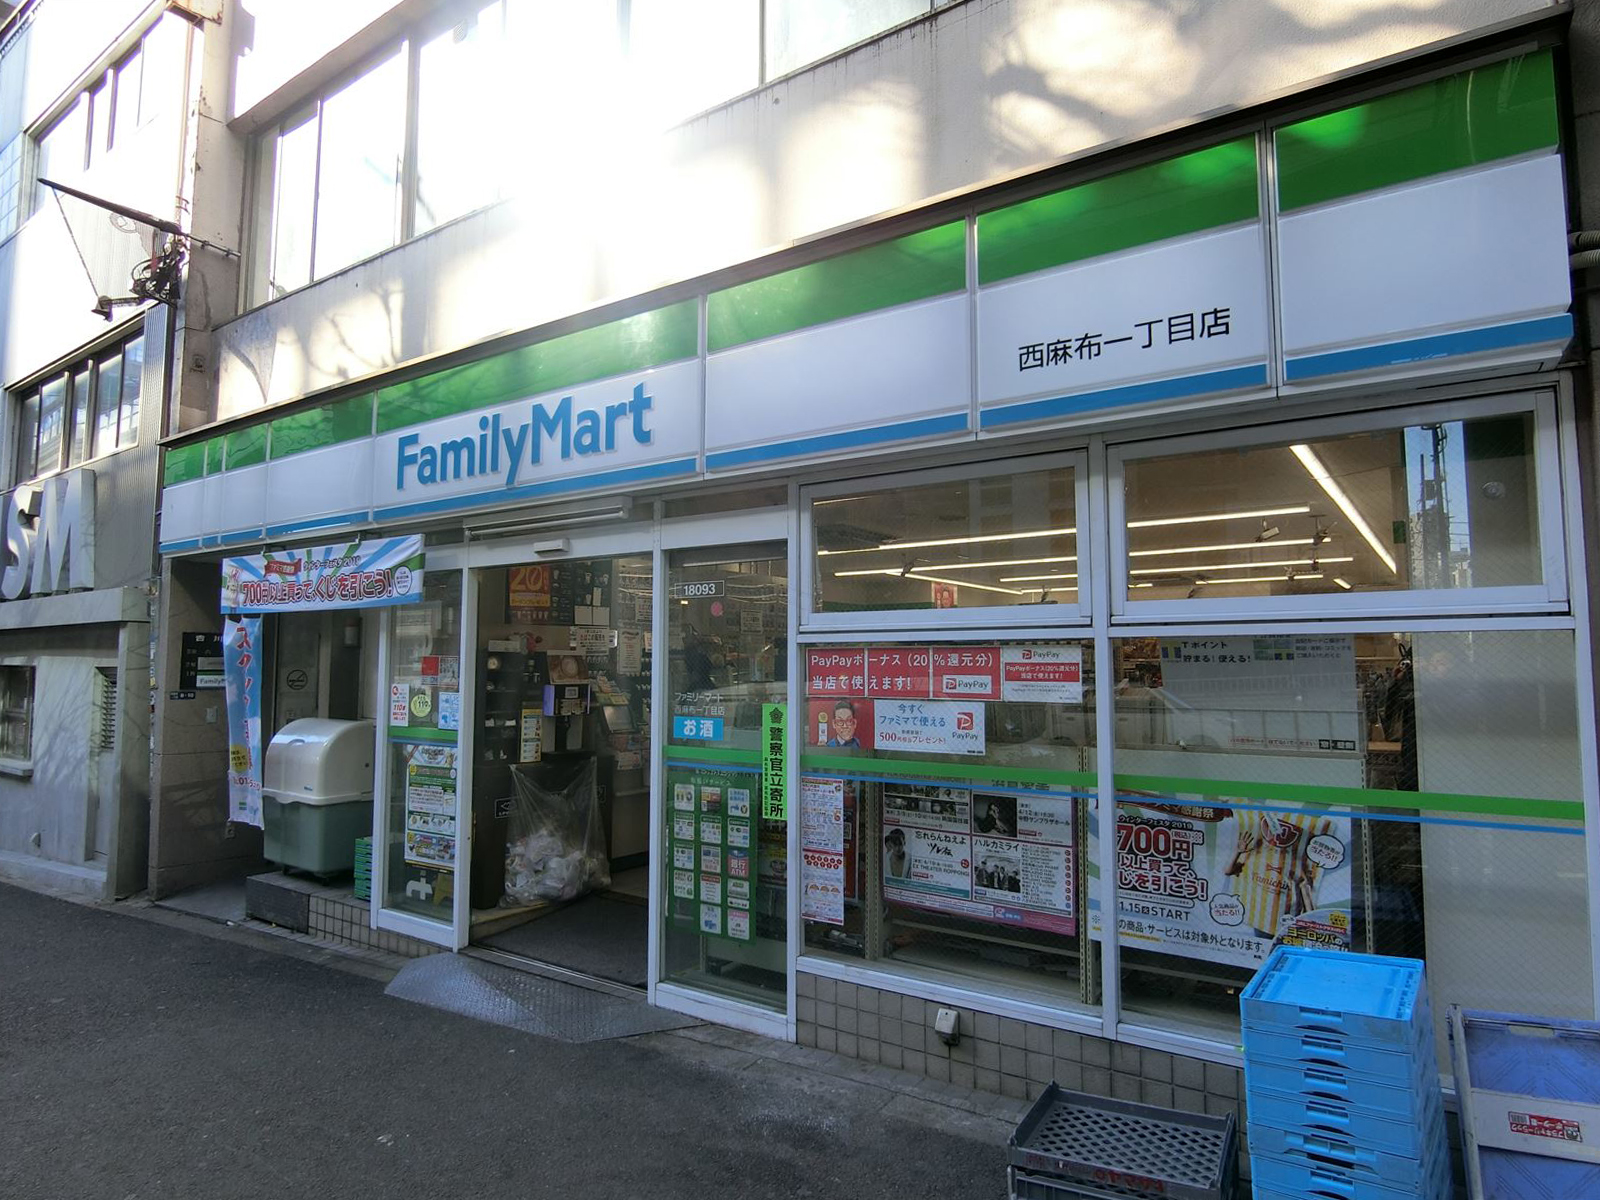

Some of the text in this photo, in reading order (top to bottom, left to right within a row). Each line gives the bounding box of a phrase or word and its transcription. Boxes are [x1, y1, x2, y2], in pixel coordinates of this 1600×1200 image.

[1018, 307, 1231, 372] 西麻布一丁目店
[397, 382, 652, 489] FamilyMart
[683, 584, 716, 595] 18093
[958, 679, 989, 689] PayPay
[674, 692, 724, 703] ファミリーマート
[879, 715, 946, 727] ファミマで使える
[683, 719, 714, 738] お酒
[952, 731, 979, 741] PayPay
[769, 727, 784, 818] 警察官立寄所
[1172, 821, 1192, 829] 2019
[974, 839, 1019, 852] ハルカミライ
